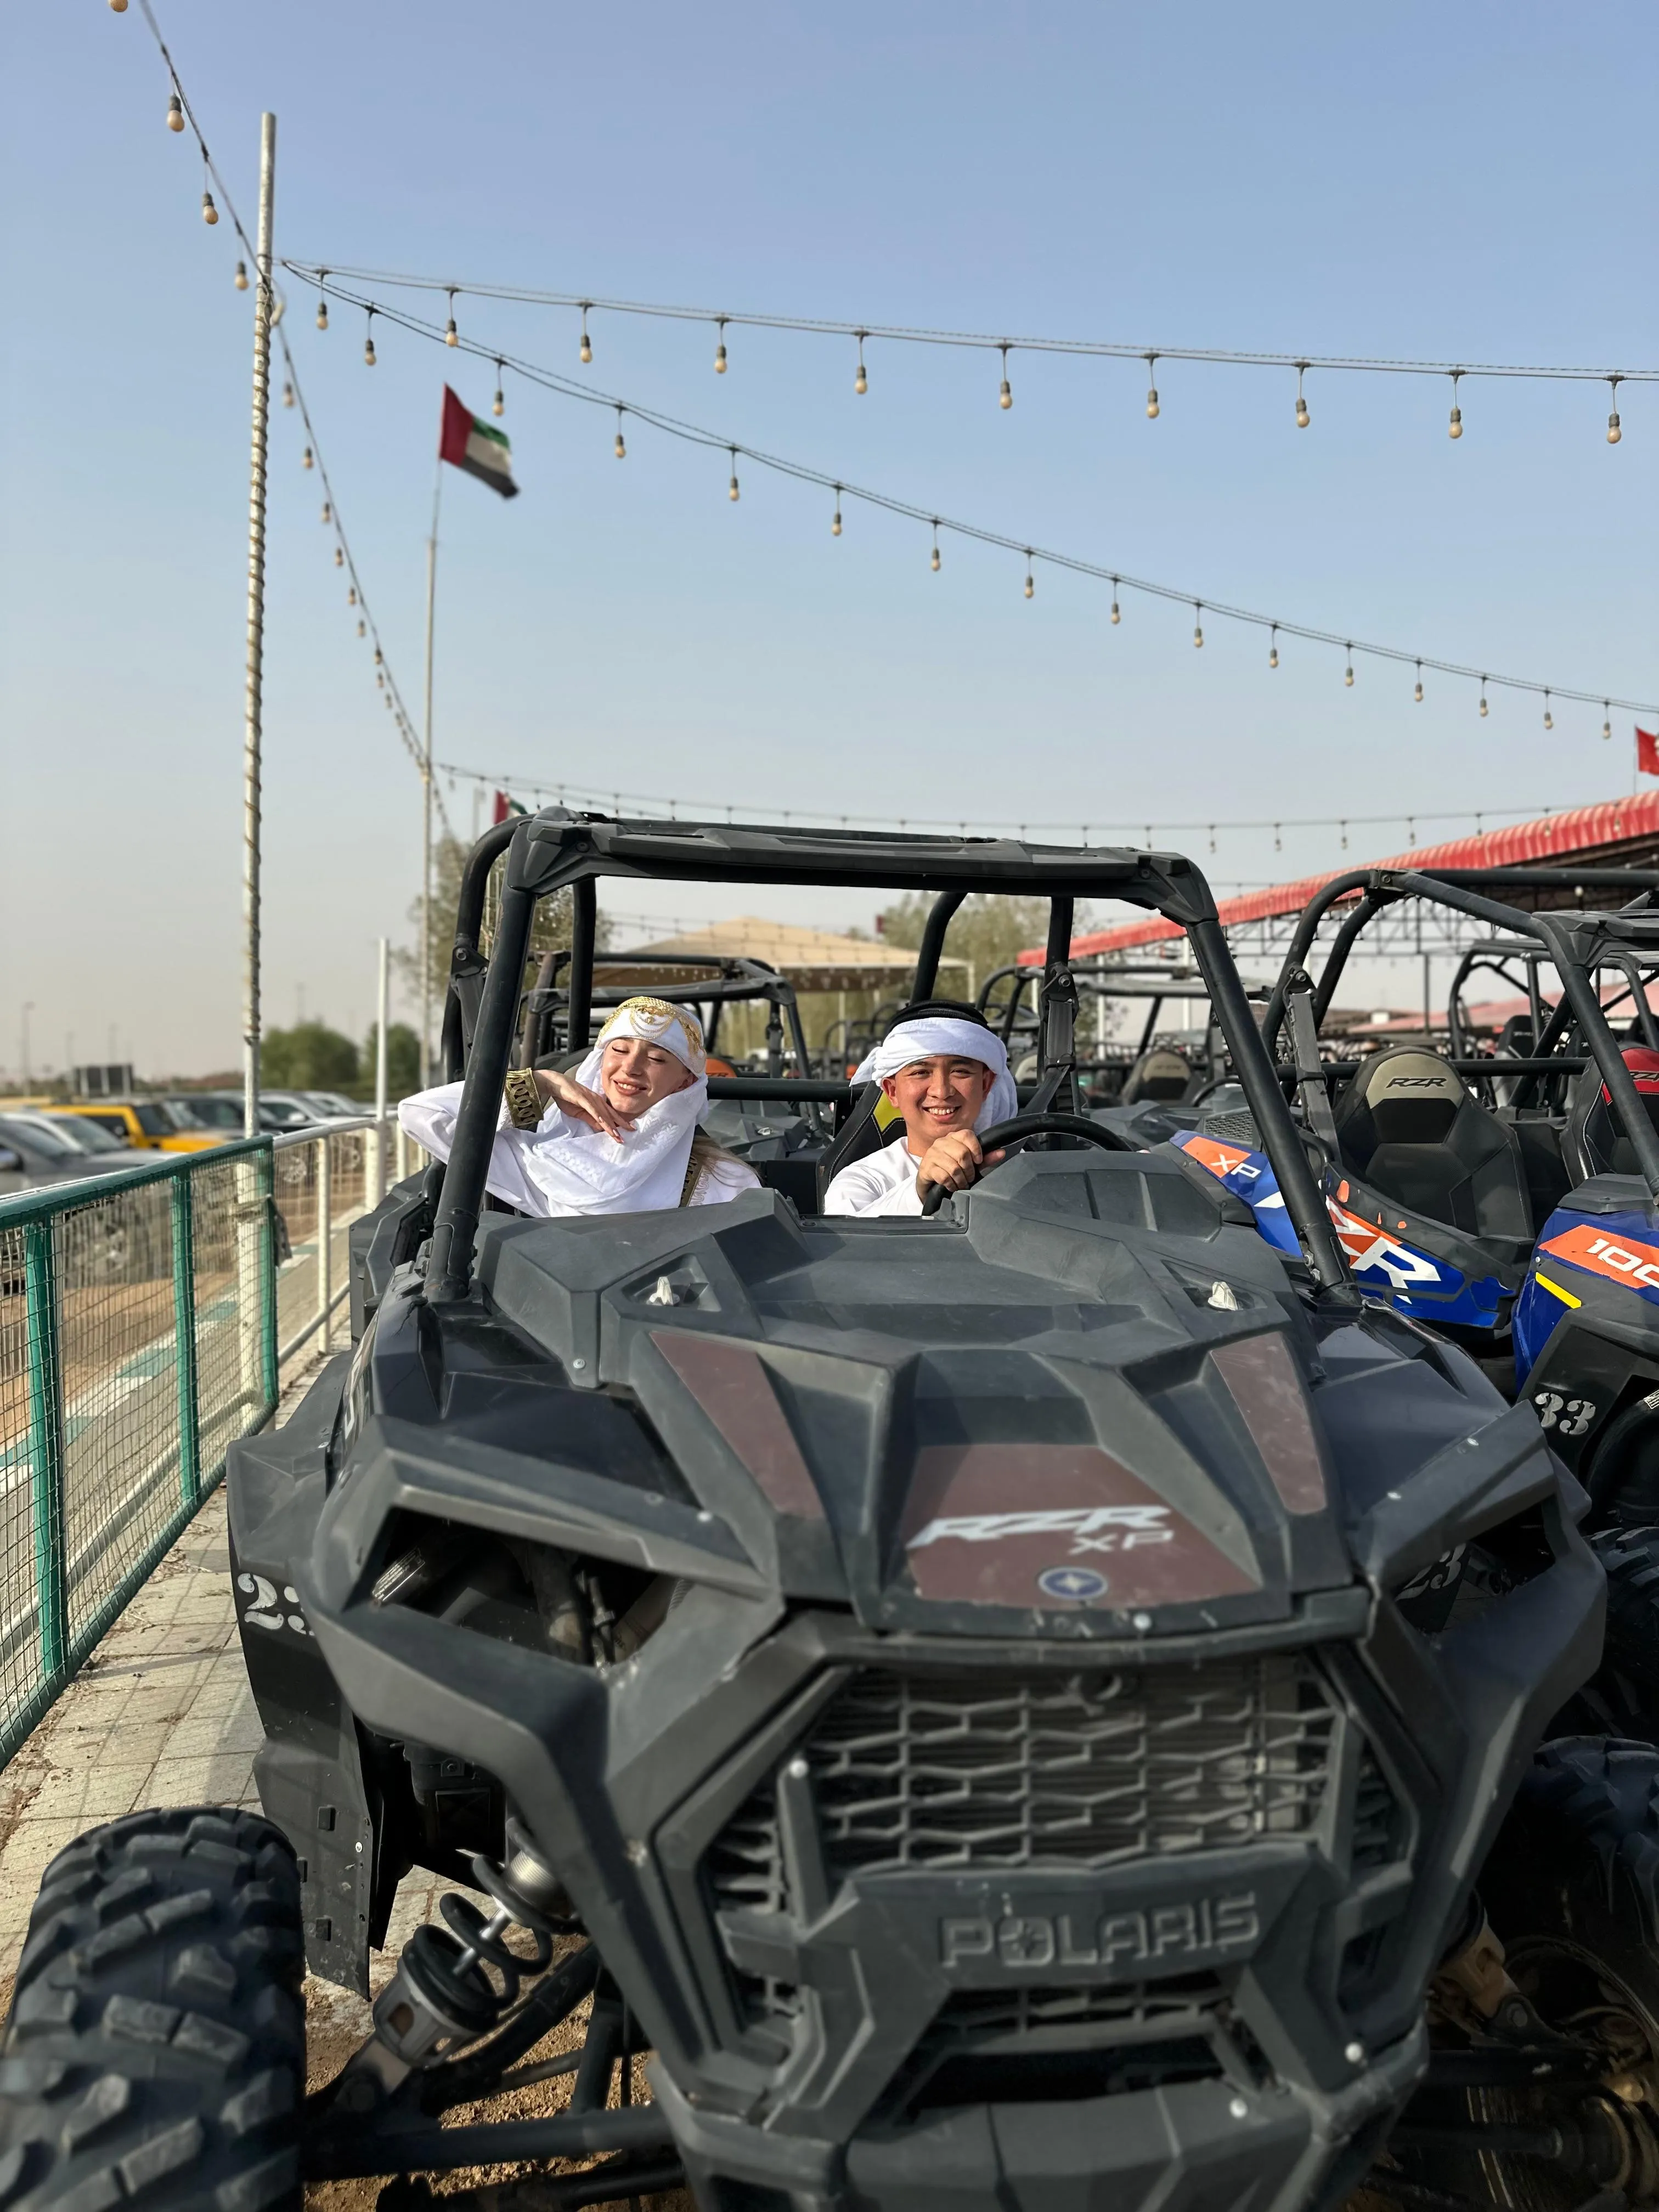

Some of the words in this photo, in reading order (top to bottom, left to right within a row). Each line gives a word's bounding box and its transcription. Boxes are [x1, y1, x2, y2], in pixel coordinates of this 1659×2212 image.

[1386, 1077, 1447, 1088] RZR
[1210, 1153, 1262, 1178] XP
[1535, 1392, 1596, 1435] 33
[905, 1505, 1172, 1550] RZR
[1067, 1531, 1174, 1556] XP
[938, 1891, 1260, 1968] POLARIS
